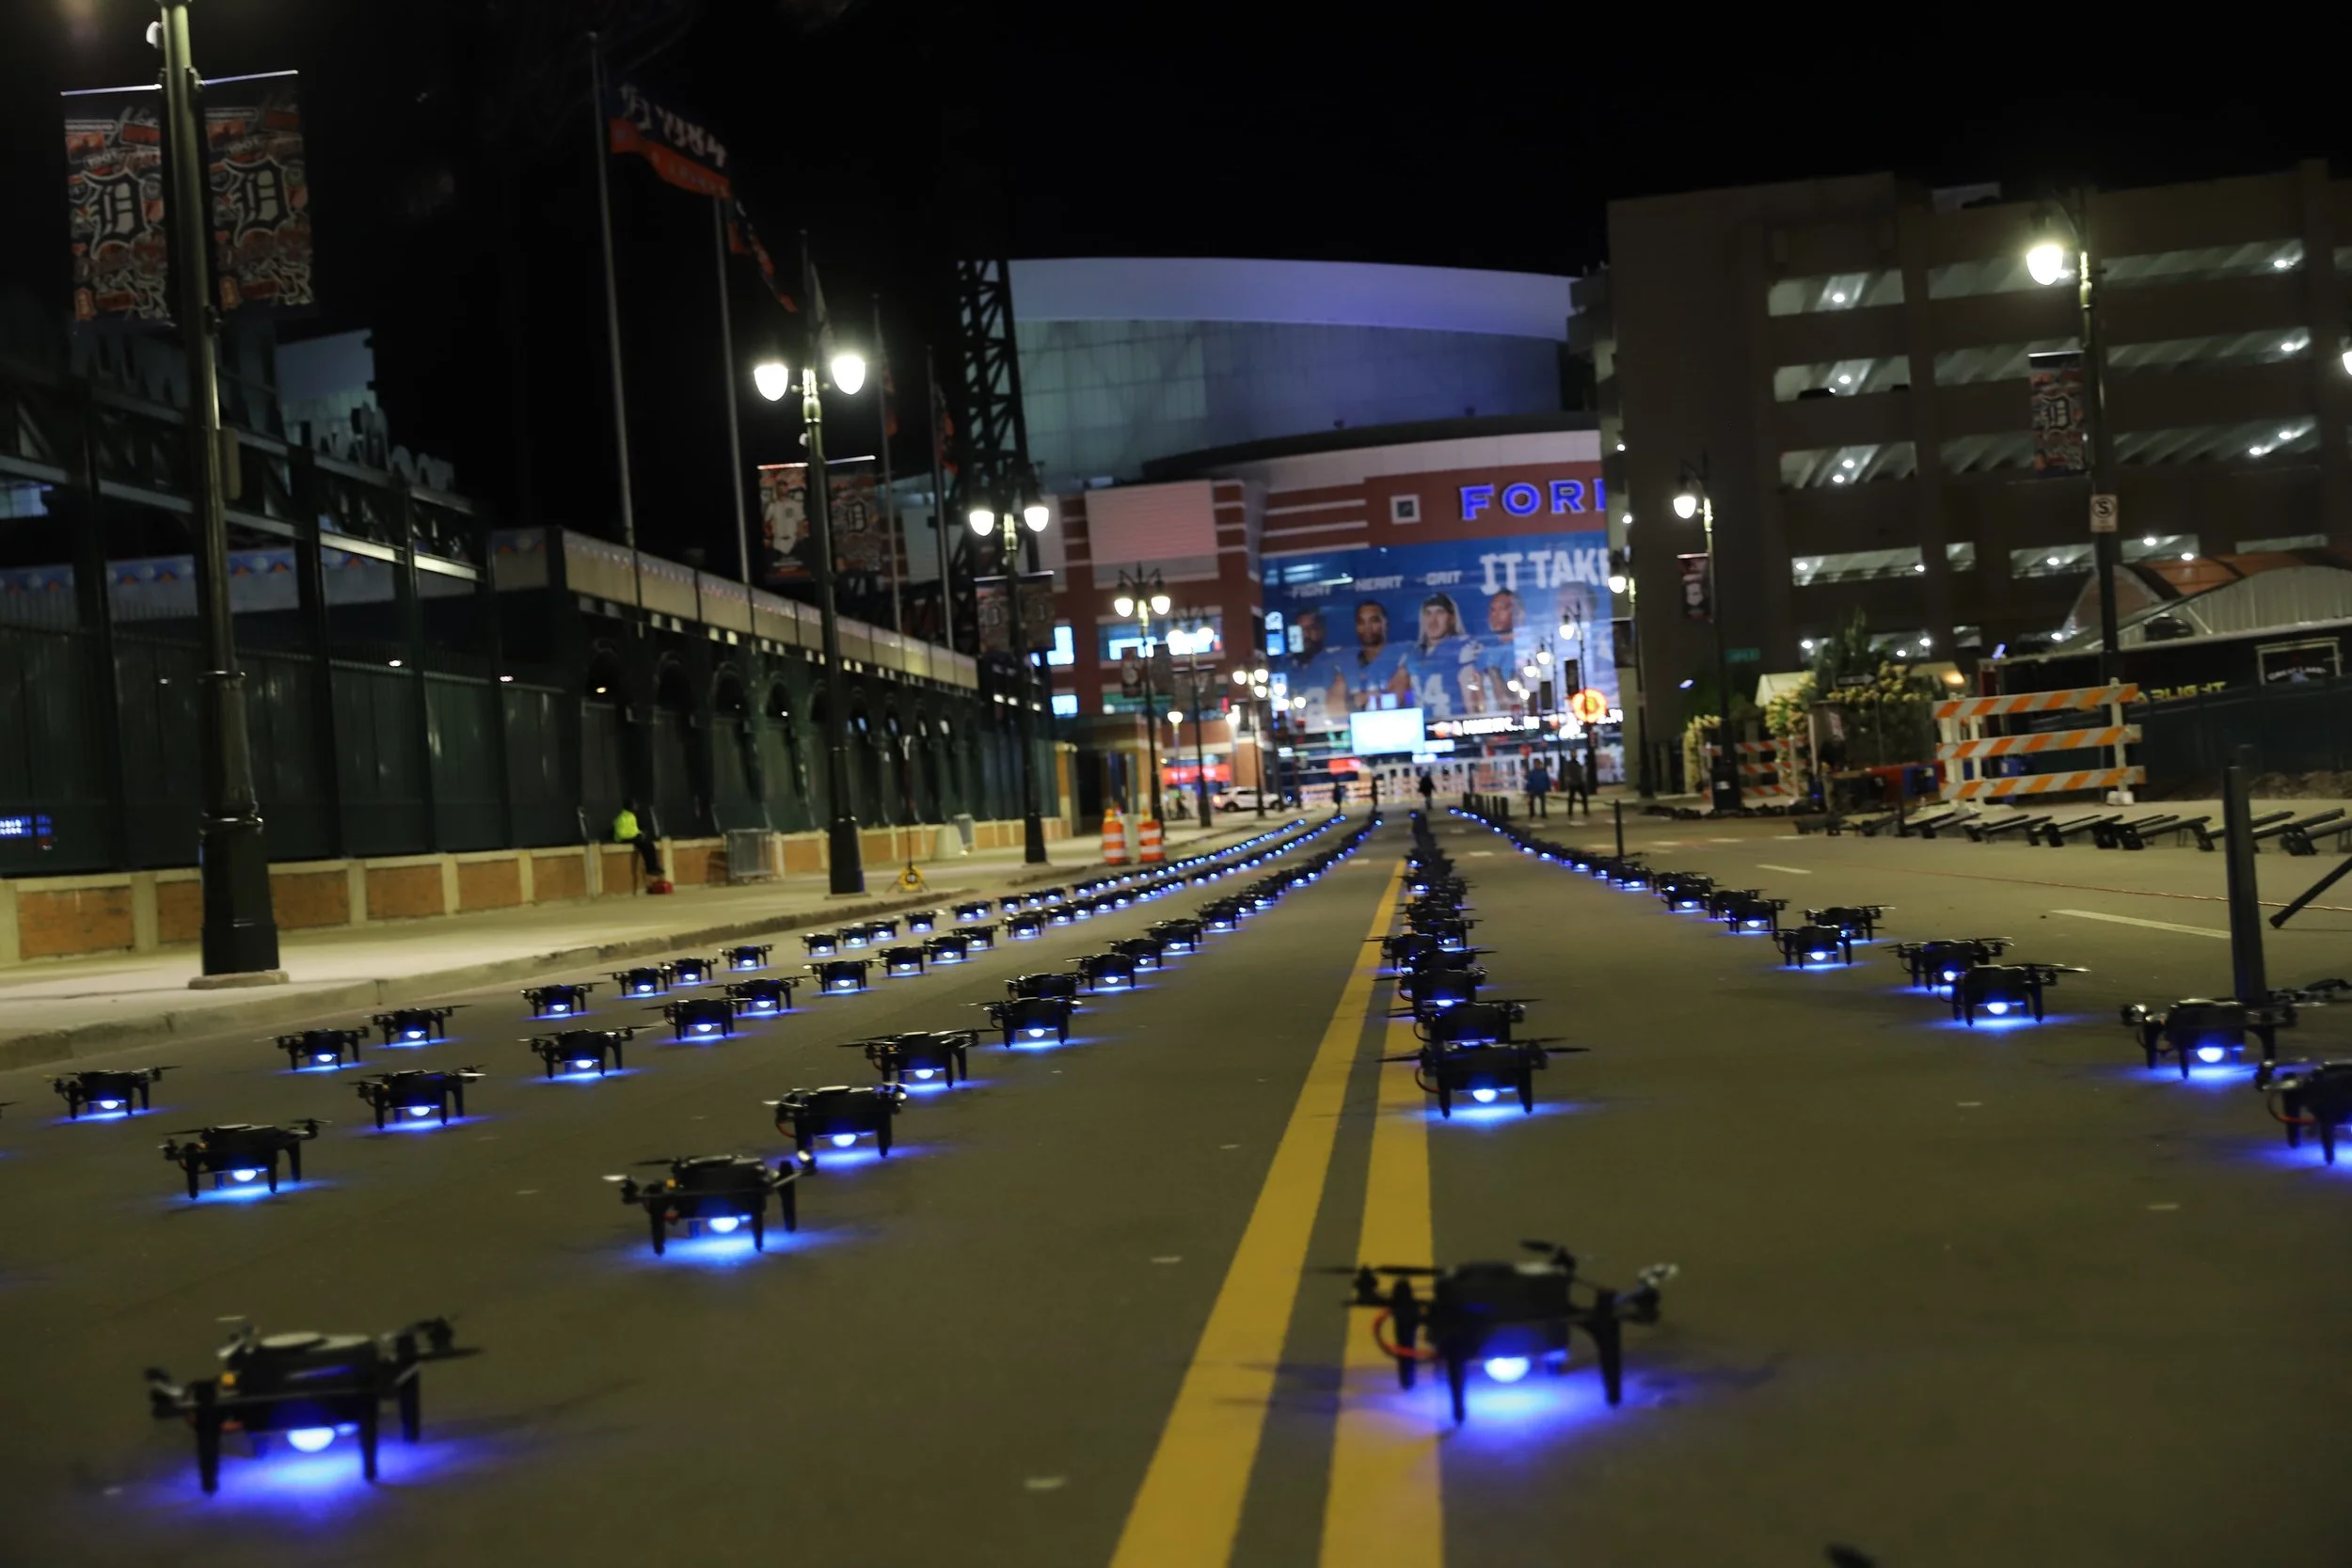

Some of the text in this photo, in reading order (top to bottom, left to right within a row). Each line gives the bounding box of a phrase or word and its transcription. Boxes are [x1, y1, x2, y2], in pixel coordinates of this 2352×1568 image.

[1460, 478, 1607, 521] FOR
[1426, 570, 1463, 587] GRIT
[1479, 552, 1523, 595] IT
